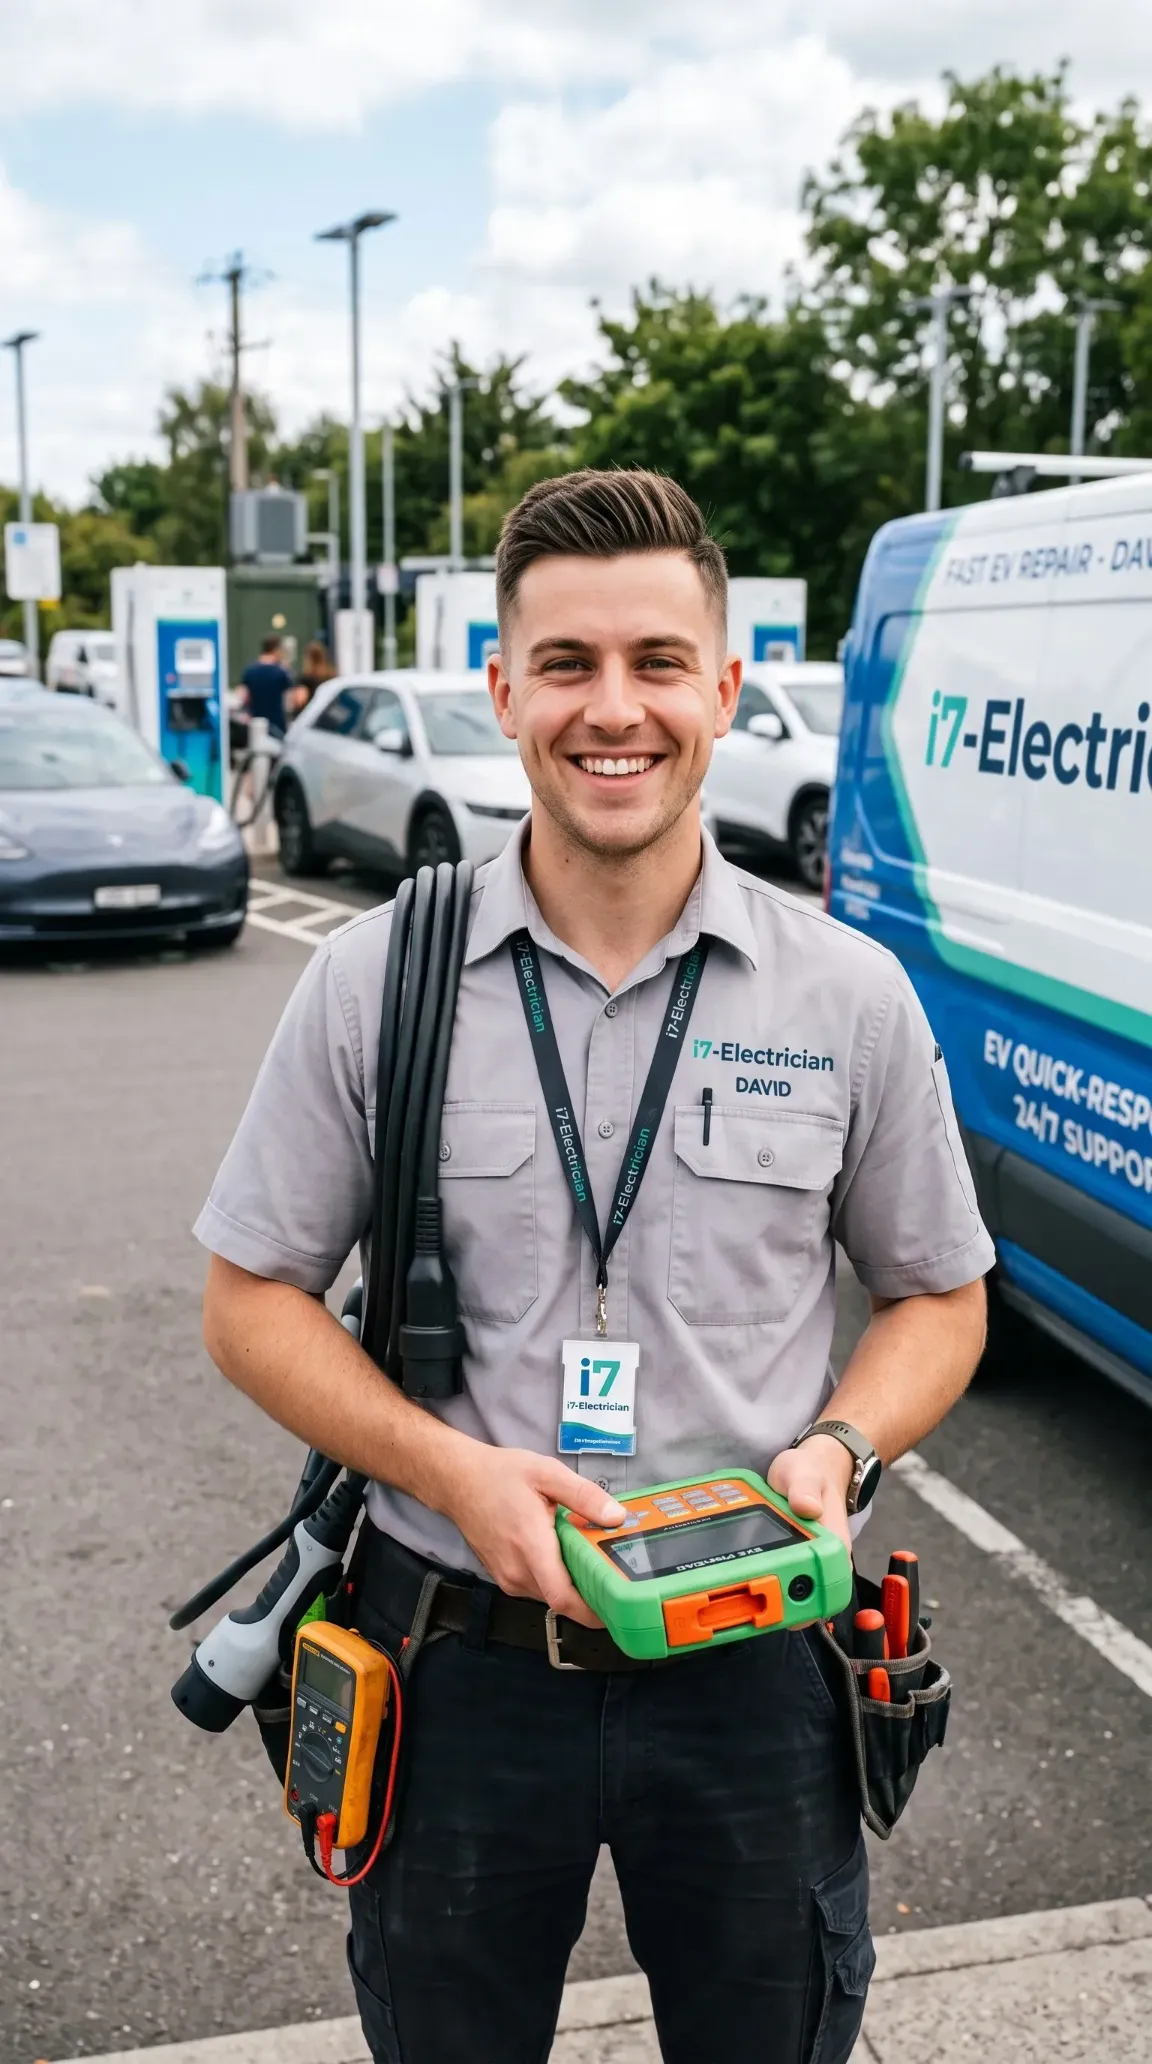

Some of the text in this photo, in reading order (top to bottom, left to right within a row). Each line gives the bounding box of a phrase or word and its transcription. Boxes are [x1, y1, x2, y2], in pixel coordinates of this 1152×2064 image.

[945, 554, 989, 585] FAST
[990, 552, 1013, 583] EV
[1018, 543, 1093, 580] REPAIR
[925, 688, 1152, 794] i7-Electri
[516, 941, 545, 1033] i7-Electrician
[692, 1038, 834, 1072] i7-Electrician
[735, 1076, 792, 1098] DAVID
[984, 1029, 1152, 1137] EV QUICK-RESP
[1012, 1093, 1060, 1144] 24/7
[555, 1106, 587, 1202] i7-Electrician
[612, 1127, 651, 1226] i7-Electrician
[579, 1357, 621, 1397] i7
[566, 1401, 630, 1412] i7-Electrician
